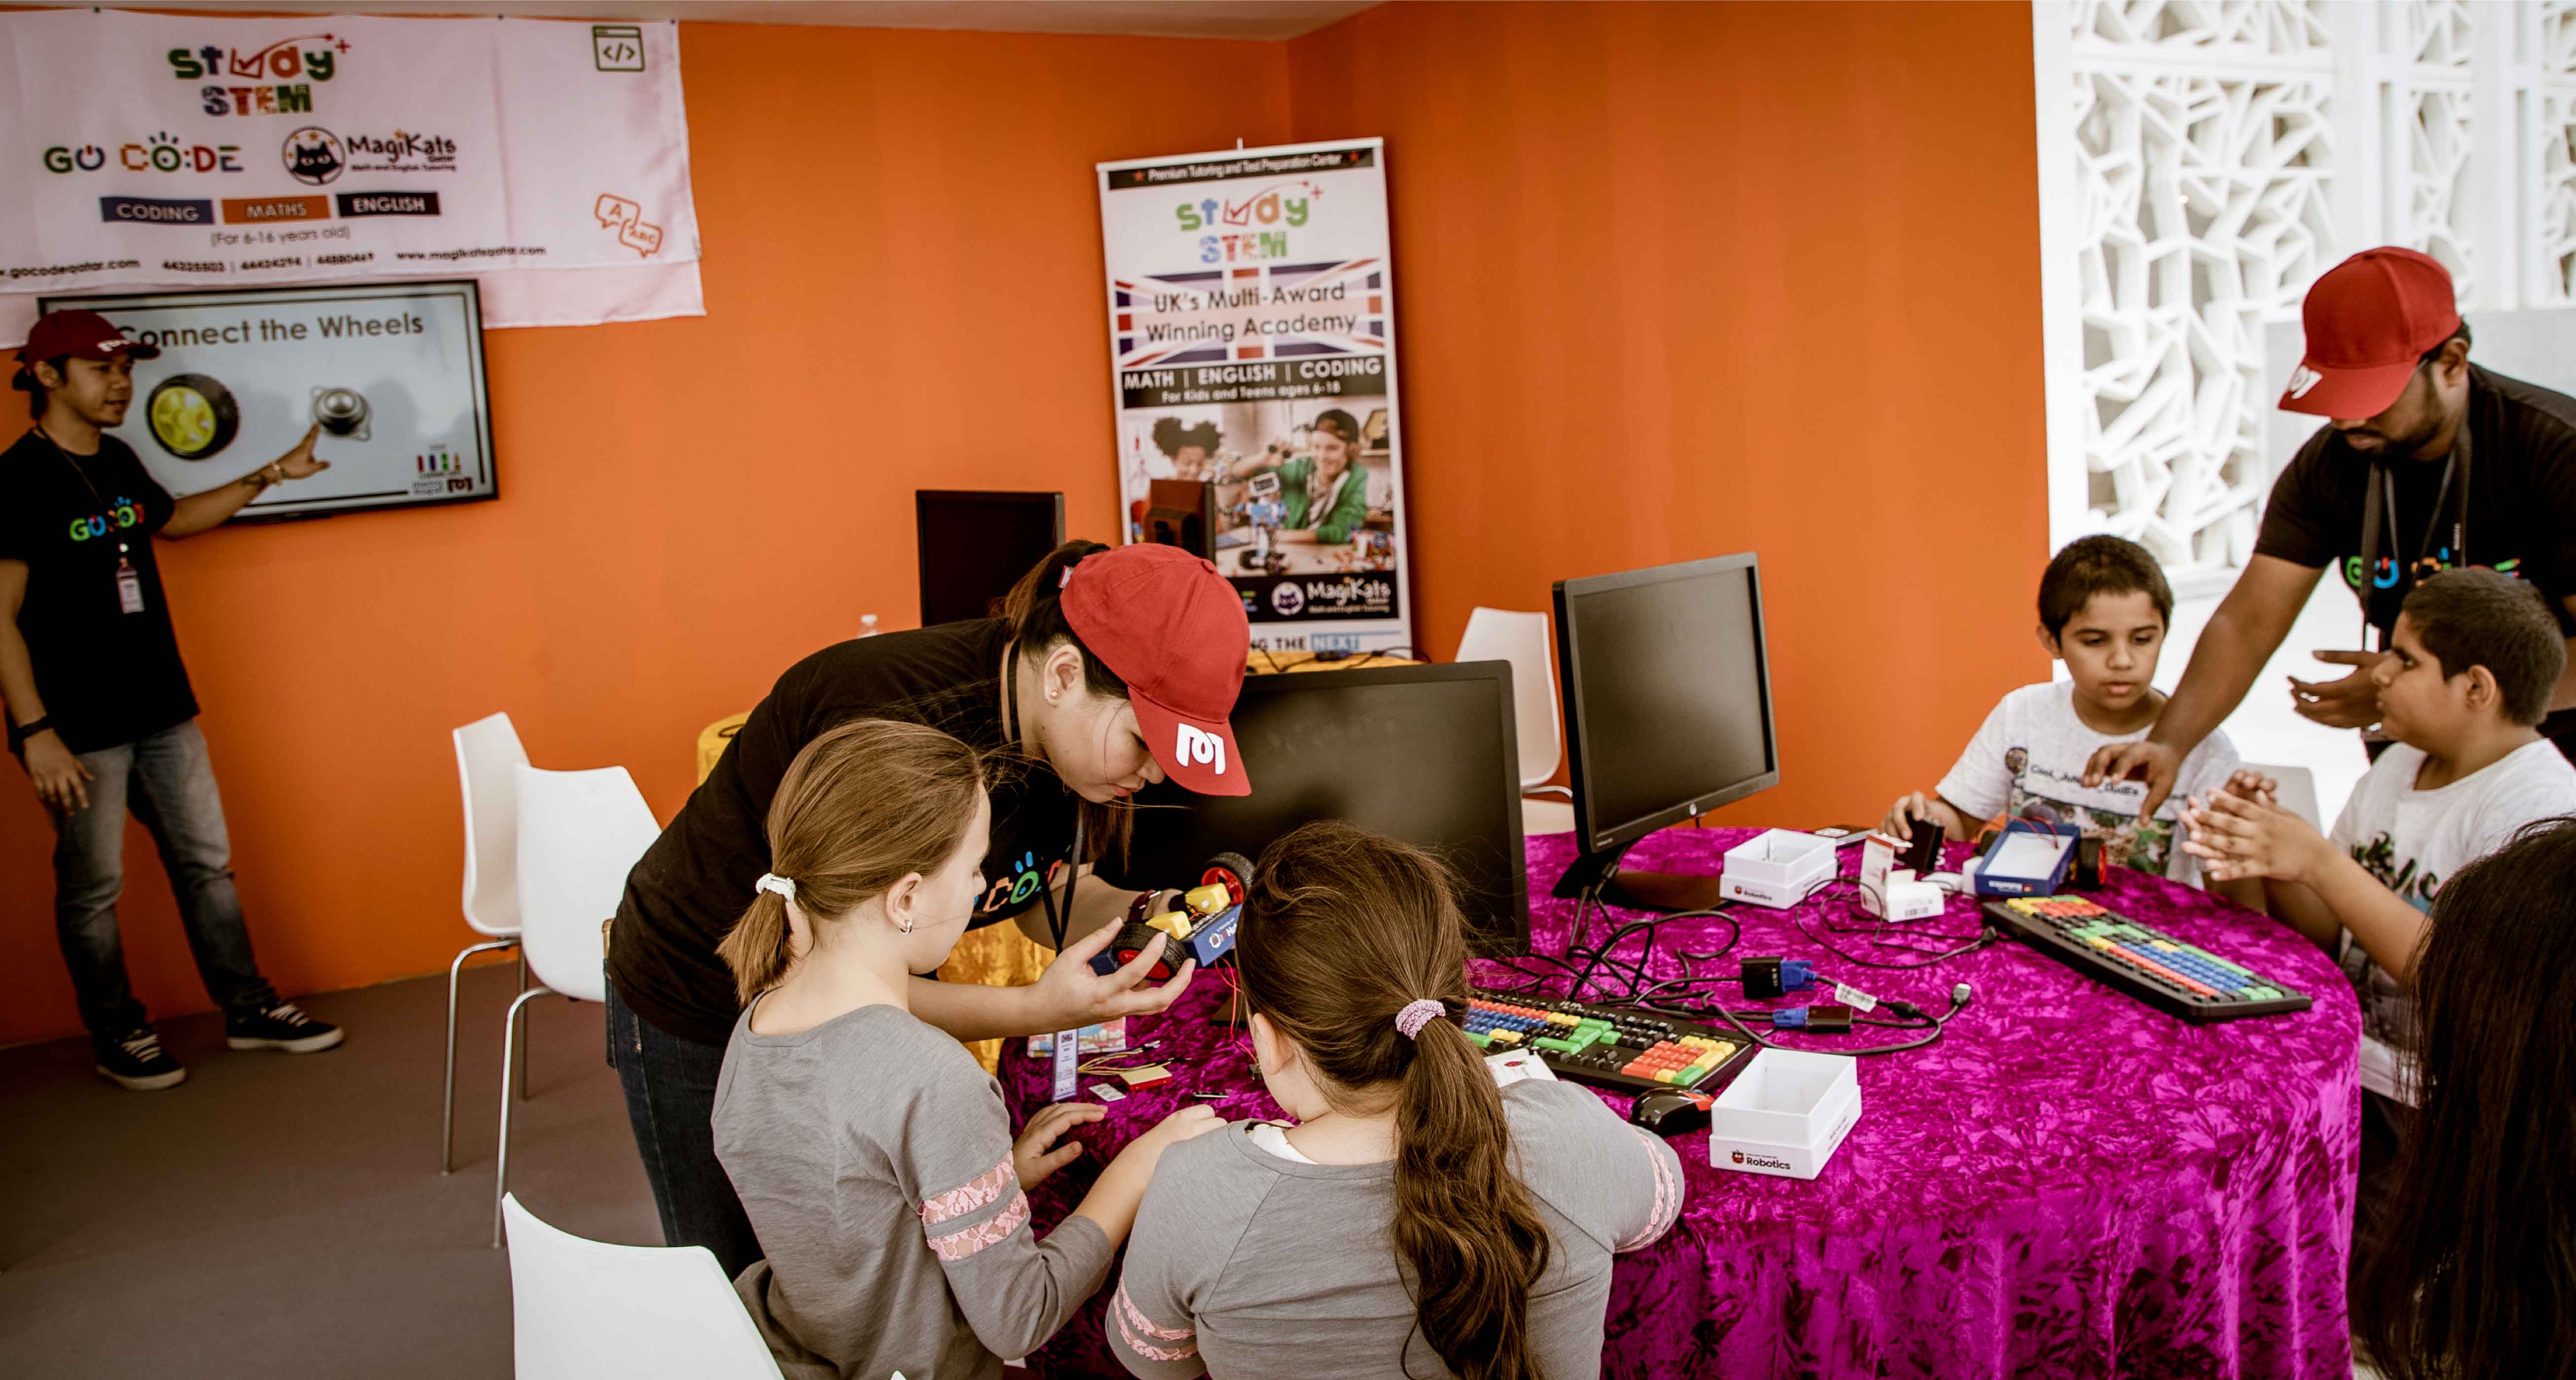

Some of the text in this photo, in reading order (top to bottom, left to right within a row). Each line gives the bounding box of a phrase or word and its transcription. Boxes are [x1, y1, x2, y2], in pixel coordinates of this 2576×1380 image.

[202, 84, 313, 115] STEM
[43, 145, 105, 173] GO
[347, 129, 457, 163] MagiKats
[1148, 154, 1342, 181] Premium Tutoring and Test Preparation Center
[116, 197, 426, 222] CODING MATHS ENGLISH
[608, 204, 622, 218] A
[211, 225, 351, 247] (For 6-16 years old)
[1200, 231, 1288, 263] STEM
[1154, 282, 1345, 313] UK's Multi-Award
[260, 319, 307, 341] the
[317, 312, 424, 338] Wheels
[1146, 312, 1356, 343] Winning Academy
[1124, 357, 1382, 390] MATH ENGLISH CODING
[1162, 380, 1341, 403] For Kids and Teens ages 6-18
[1307, 578, 1391, 606] MagiKats
[1276, 636, 1305, 650] THE
[1747, 1157, 1791, 1170] Robotics
